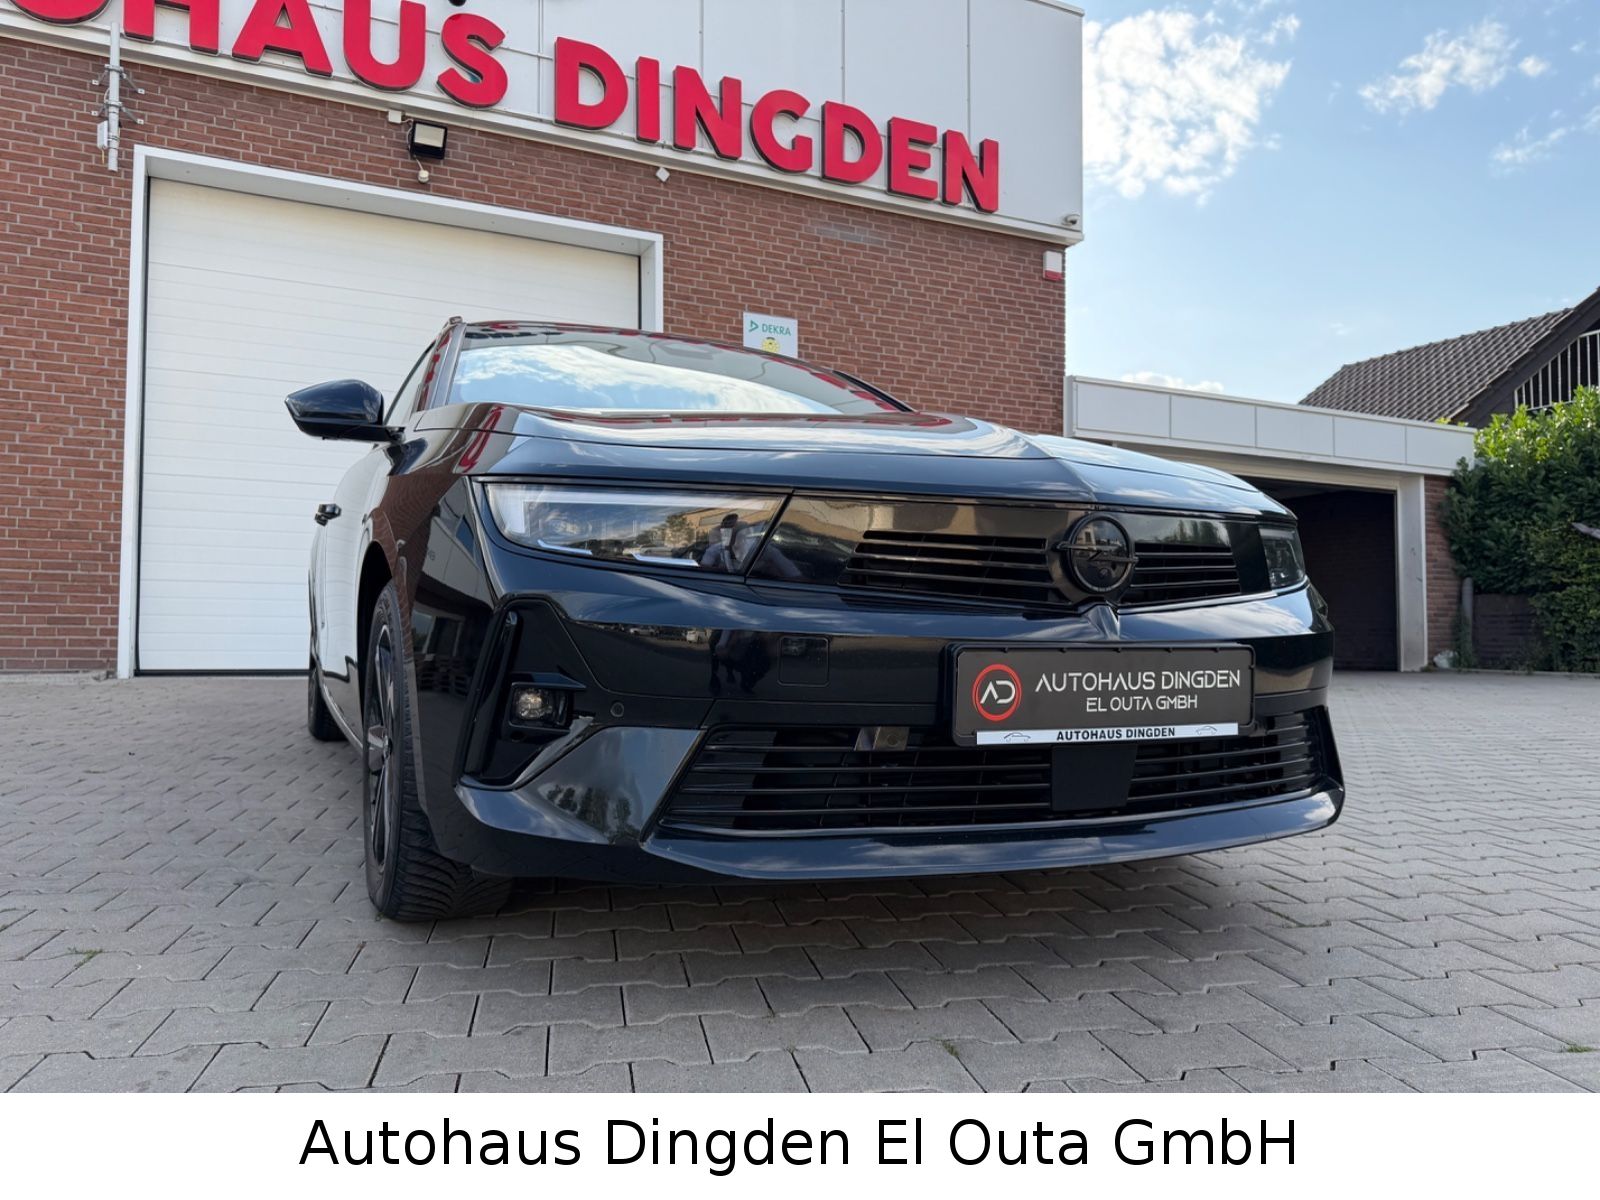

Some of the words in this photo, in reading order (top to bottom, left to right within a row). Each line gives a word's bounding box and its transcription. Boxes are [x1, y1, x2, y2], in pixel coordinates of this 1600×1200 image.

[554, 36, 999, 214] DINGDEN
[761, 323, 792, 336] DEKRA
[1035, 671, 1156, 693] AUTOHAUS
[1161, 669, 1241, 690] DINGDEN
[979, 680, 1016, 704] AD
[1086, 696, 1108, 713] EL
[1110, 695, 1154, 711] OUTA
[1156, 694, 1198, 710] GMBH
[1056, 730, 1122, 741] AUTOHAUS
[1126, 727, 1176, 738] DINGDEN
